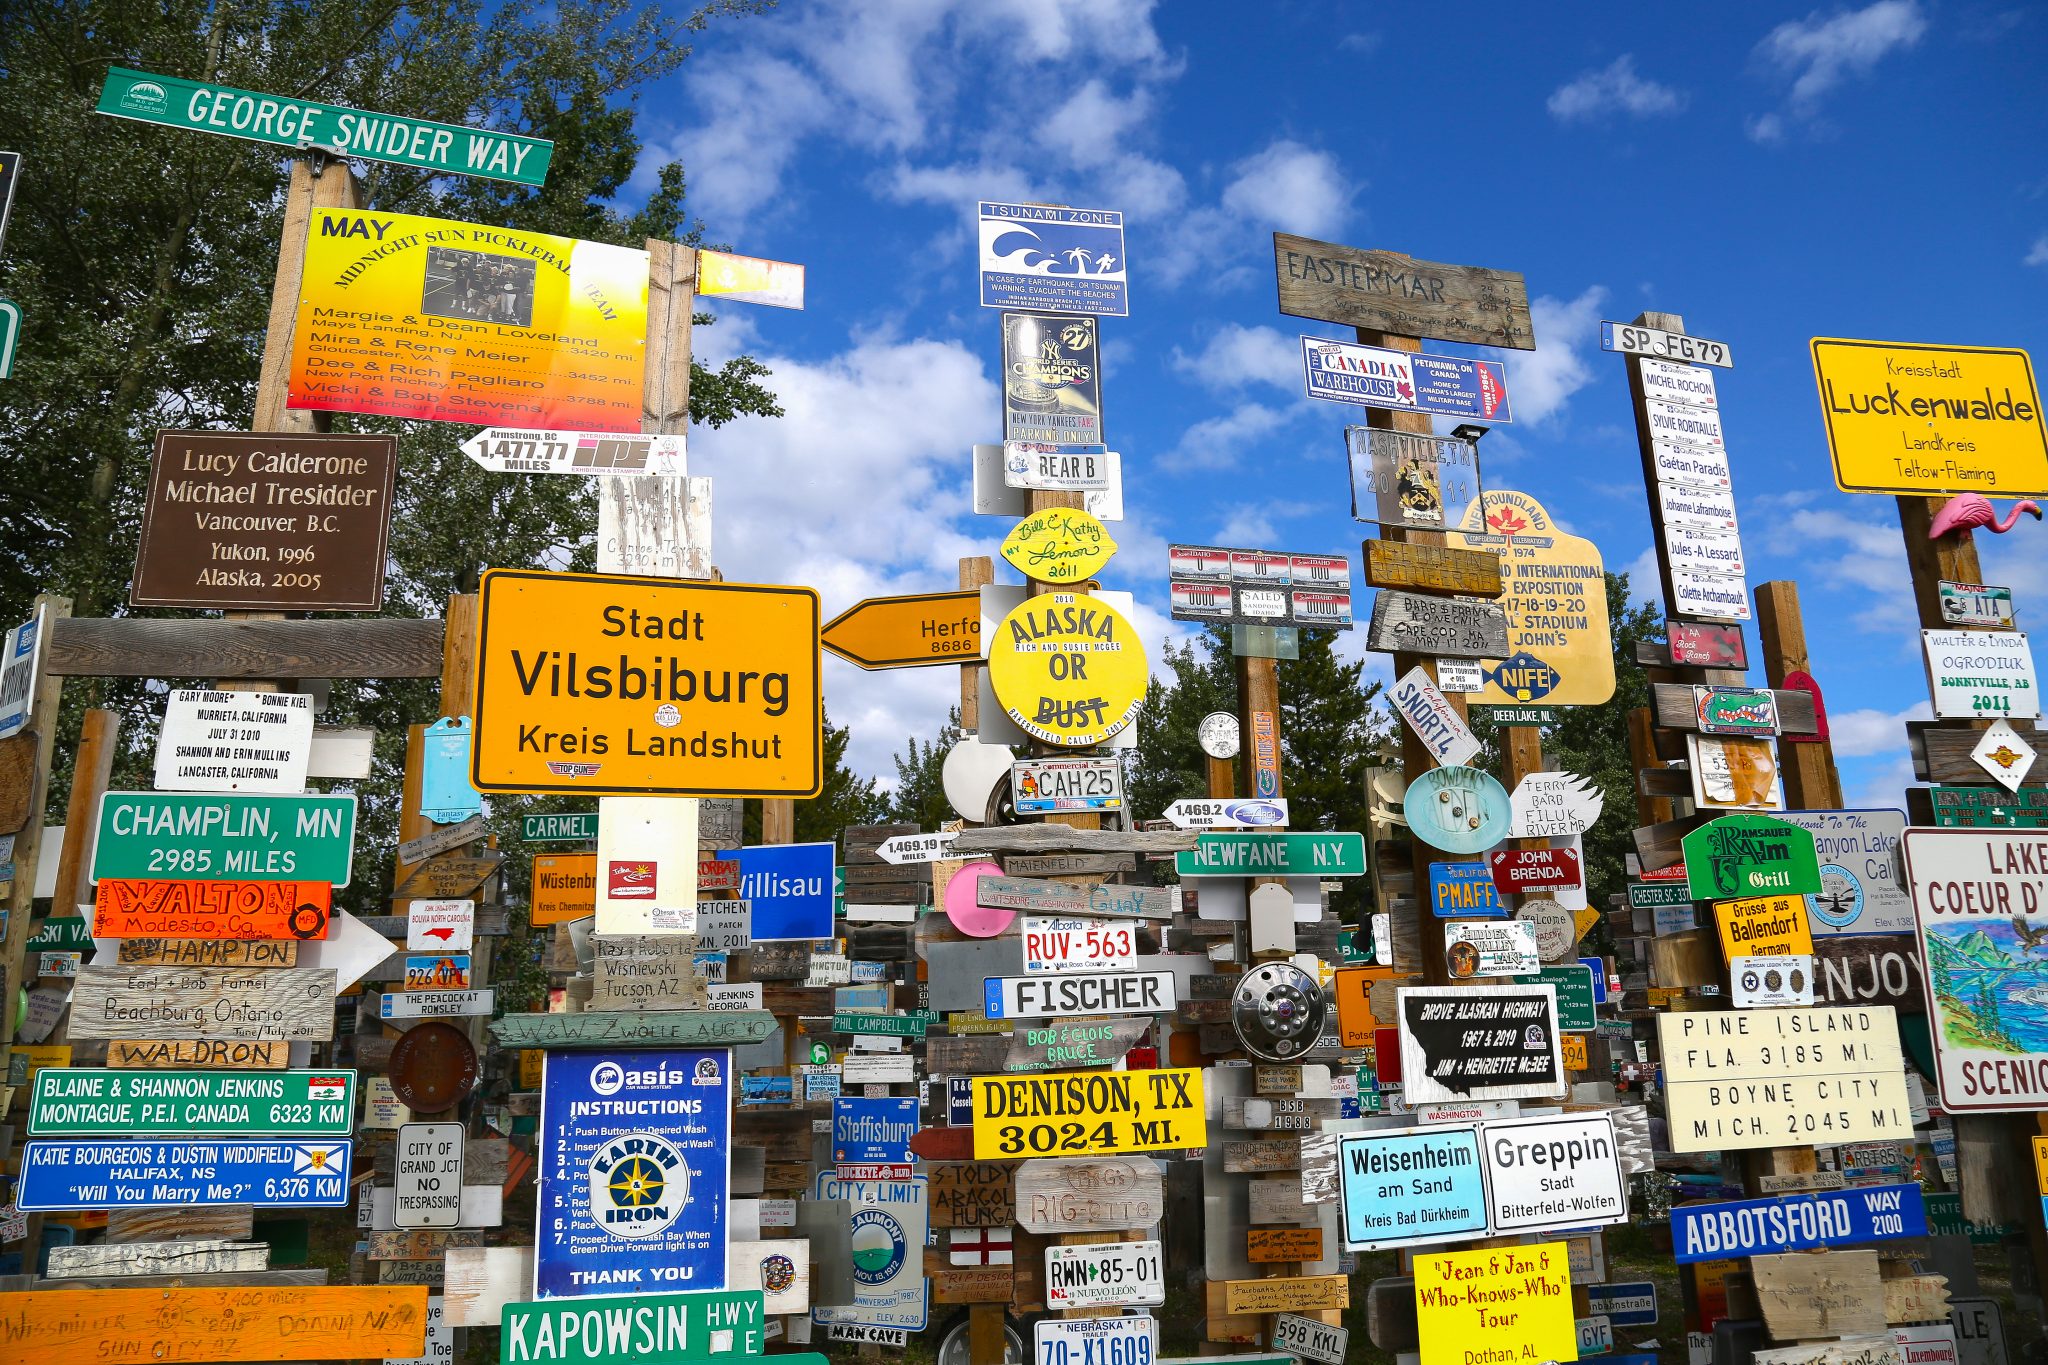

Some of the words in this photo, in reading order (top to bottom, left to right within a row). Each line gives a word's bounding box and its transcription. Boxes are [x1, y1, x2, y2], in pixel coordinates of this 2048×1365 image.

[188, 88, 322, 141] GEORGE
[332, 114, 455, 165] SNIDER
[467, 135, 534, 176] WAY
[989, 204, 1062, 221] TSUNAMI
[1070, 211, 1114, 225] ZONE
[321, 215, 395, 241] MAY
[1287, 251, 1445, 304] EASTERMAR
[991, 283, 1027, 295] WARNING,
[1028, 286, 1067, 297] EVACUATE
[1068, 289, 1083, 298] THE
[313, 307, 394, 327] Margie
[402, 319, 419, 331] &
[427, 318, 489, 338] Dean
[498, 327, 599, 351] Loveland
[1325, 353, 1408, 381] CANADIAN
[1414, 358, 1459, 374] PETAWAWA,
[1460, 364, 1474, 375] ON
[1430, 369, 1461, 381] CANADA
[1314, 371, 1395, 399] WAREHOUSE
[1826, 378, 2034, 421] Luckenwalde
[490, 430, 544, 441] Armstrong,
[544, 432, 557, 441] BC
[1013, 427, 1060, 441] PARKING
[1063, 430, 1096, 443] ONLY!
[1653, 414, 1676, 431] SYLVIE
[1677, 416, 1719, 437] ROBITAILLE
[1902, 430, 1977, 453] Landkreis
[477, 440, 578, 464] 1,477.77
[183, 450, 241, 477] Lucy
[248, 451, 368, 475] Calderone
[505, 459, 551, 471] MILES
[1657, 453, 1692, 475] Gaétan
[1692, 460, 1727, 477] Paradis
[1048, 564, 1077, 577] 2011
[1242, 590, 1282, 602] SAIED
[1242, 602, 1283, 611] SANDPOINT
[601, 605, 704, 641] Stadt
[1009, 607, 1114, 644] ALASKA
[1524, 616, 1588, 631] STADIUM
[931, 639, 972, 653] 8686
[1014, 643, 1037, 653] RICH
[1041, 643, 1058, 652] AND
[1063, 643, 1089, 652] SUSIE
[1094, 641, 1120, 651] MCGEE
[1514, 630, 1568, 648] JOHN'S
[1049, 653, 1088, 681] OR
[1941, 655, 2026, 672] OGRODIUK
[510, 648, 789, 718] Vilsbiburg
[1501, 667, 1549, 689] NIFE
[1940, 676, 2013, 691] BONNYVILLE,
[2014, 677, 2030, 689] AB
[1036, 696, 1106, 728] BUST
[1971, 694, 2011, 711] 2011
[197, 708, 241, 723] MURRIETA,
[241, 711, 288, 725] CALIFORNIA
[1493, 709, 1515, 722] DEER
[1515, 709, 1540, 724] LAKE,
[1540, 709, 1553, 722] NL
[518, 724, 610, 756] Kreis
[626, 728, 783, 760] Landshut
[559, 763, 574, 774] TOP
[574, 764, 589, 775] GUN
[1524, 780, 1567, 792] TERRY
[1174, 802, 1222, 817] 1,469.2
[113, 803, 280, 845] CHAMPLIN,
[295, 807, 343, 839] MN
[525, 816, 596, 840] CARMEL,
[1189, 817, 1214, 825] MILES
[887, 838, 938, 853] 1,469.19
[1193, 841, 1290, 867] NEWFANE
[1312, 841, 1347, 867] N.Y.
[147, 848, 212, 874] 2985
[223, 850, 298, 874] MILES
[901, 852, 926, 861] MILES
[1516, 850, 1552, 864] JOHN
[1510, 866, 1564, 881] BRENDA
[1747, 870, 1792, 888] Grill
[1927, 879, 2013, 916] COEUR
[1732, 901, 1767, 918] Grüsse
[1773, 899, 1790, 912] aus
[125, 916, 223, 938] Modesto,
[1047, 919, 1083, 932] Alberta
[1729, 915, 1799, 943] Ballendorf
[160, 938, 289, 964] HAMPTON
[604, 960, 677, 976] Wisniewski
[603, 978, 655, 998] Tucson,
[657, 977, 679, 996] AZ
[716, 990, 755, 1000] JENKINS
[1016, 976, 1162, 1013] FISCHER
[405, 994, 423, 1004] THE
[424, 993, 464, 1004] PEACOCK
[466, 992, 478, 1002] AT
[707, 1000, 748, 1011] GEORGIA
[421, 1004, 462, 1014] ROMSLEY
[1420, 1003, 1456, 1021] DROVE
[1456, 1002, 1500, 1020] ALASKAN
[1501, 1001, 1547, 1019] HIGHWAY
[834, 1014, 854, 1030] PHIL
[857, 1017, 906, 1033] CAMPBELL,
[1683, 1016, 1749, 1037] PINE
[1775, 1012, 1870, 1035] ISLAND
[119, 1040, 272, 1066] WALDRON
[1047, 1043, 1097, 1062] BRUCE
[1687, 1047, 1741, 1069] FLA.
[1759, 1044, 1824, 1066] 3185
[1842, 1043, 1874, 1062] MI.
[43, 1078, 103, 1098] BLAINE
[110, 1078, 122, 1098] &
[129, 1077, 211, 1099] SHANNON
[215, 1078, 284, 1099] JENKINS
[983, 1073, 1140, 1119] DENISON,
[1149, 1071, 1194, 1110] TX
[570, 1099, 702, 1116] INSTRUCTIONS
[837, 1115, 914, 1143] Steffisburg
[998, 1120, 1119, 1154] 3024
[1131, 1119, 1181, 1146] MI.
[1350, 1140, 1473, 1176] Weisenheim
[1493, 1130, 1610, 1173] Greppin
[400, 1160, 436, 1174] GRAND
[440, 1159, 460, 1173] JCT
[114, 1185, 145, 1201] You
[152, 1185, 200, 1203] Marry
[417, 1177, 441, 1191] NO
[826, 1181, 865, 1201] CITY
[877, 1183, 921, 1204] LIMIT
[1377, 1181, 1404, 1199] am
[1411, 1176, 1454, 1196] Sand
[399, 1195, 459, 1211] TRESPASSING
[1501, 1193, 1617, 1220] Bitterfeld-Wolfen
[1685, 1198, 1853, 1256] ABBOTSFORD
[1863, 1189, 1903, 1214] WAY
[1871, 1212, 1903, 1236] 2100
[570, 1243, 599, 1255] Green
[600, 1242, 625, 1253] Drive
[626, 1242, 664, 1252] Forward
[665, 1241, 685, 1253] light
[686, 1241, 695, 1251] is
[696, 1242, 710, 1251] on
[570, 1269, 643, 1285] THANK
[649, 1266, 694, 1281] YOU
[1076, 1287, 1111, 1298] NUEVO
[1111, 1284, 1137, 1297] LEÓN
[508, 1304, 688, 1363] KAPOWSIN
[705, 1300, 758, 1327] HWY
[831, 1325, 866, 1340] MAN
[868, 1328, 903, 1345] CAVE
[1066, 1320, 1124, 1332] NEBRASKA
[1277, 1320, 1307, 1343] 598
[1312, 1330, 1342, 1355] KKL
[1463, 1348, 1517, 1365] Dothan,
[1521, 1343, 1539, 1360] AL
[1906, 1346, 1954, 1365] Luxembourg
